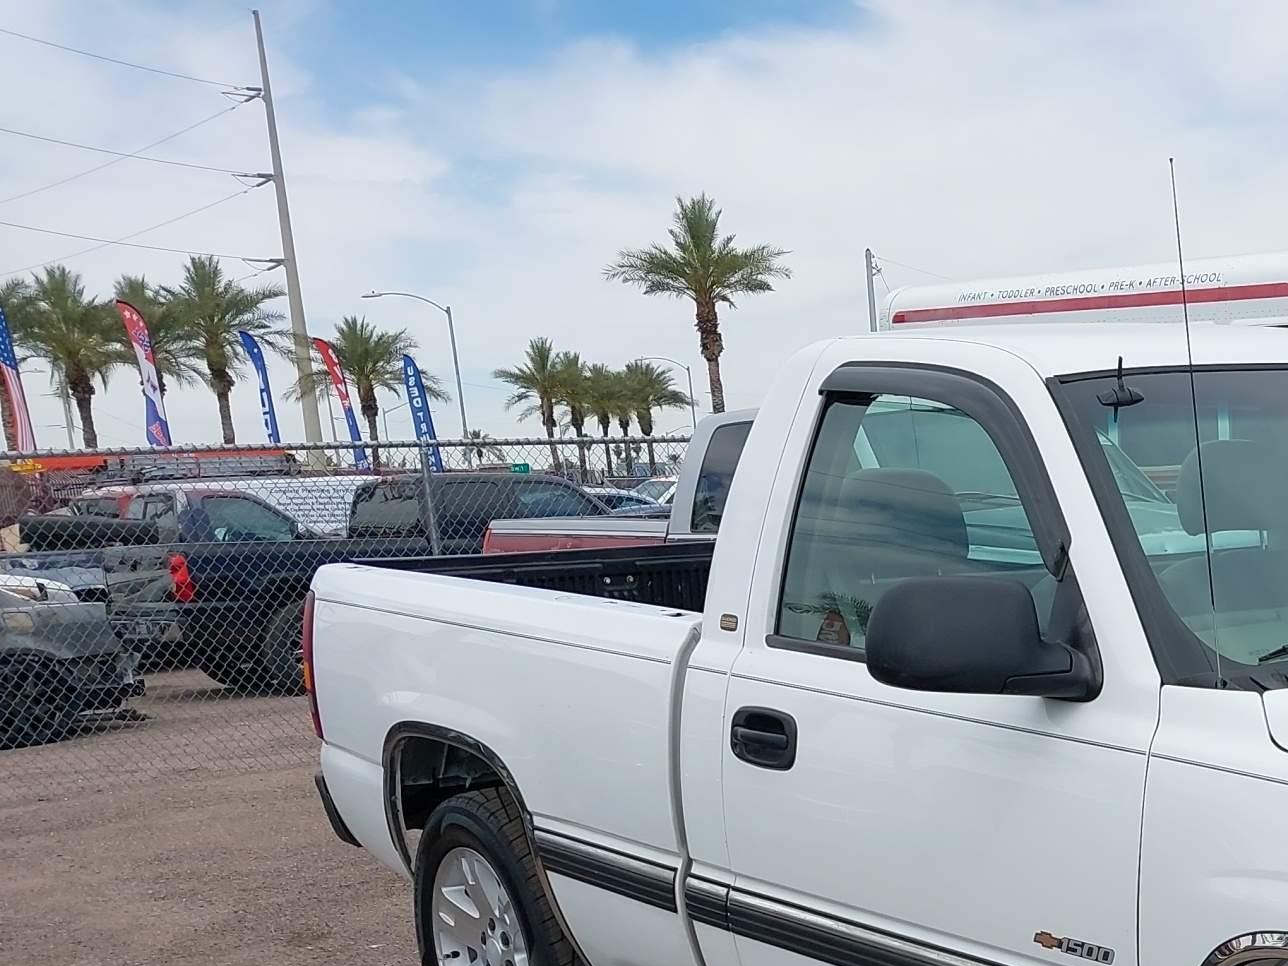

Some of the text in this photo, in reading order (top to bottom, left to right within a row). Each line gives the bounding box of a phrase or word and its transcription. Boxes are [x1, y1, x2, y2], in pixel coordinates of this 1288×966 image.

[958, 272, 1222, 303] INFANT TODDLER PRESCHOOL PRE-K AFTER-SCHOOL
[1061, 937, 1115, 965] 1500
